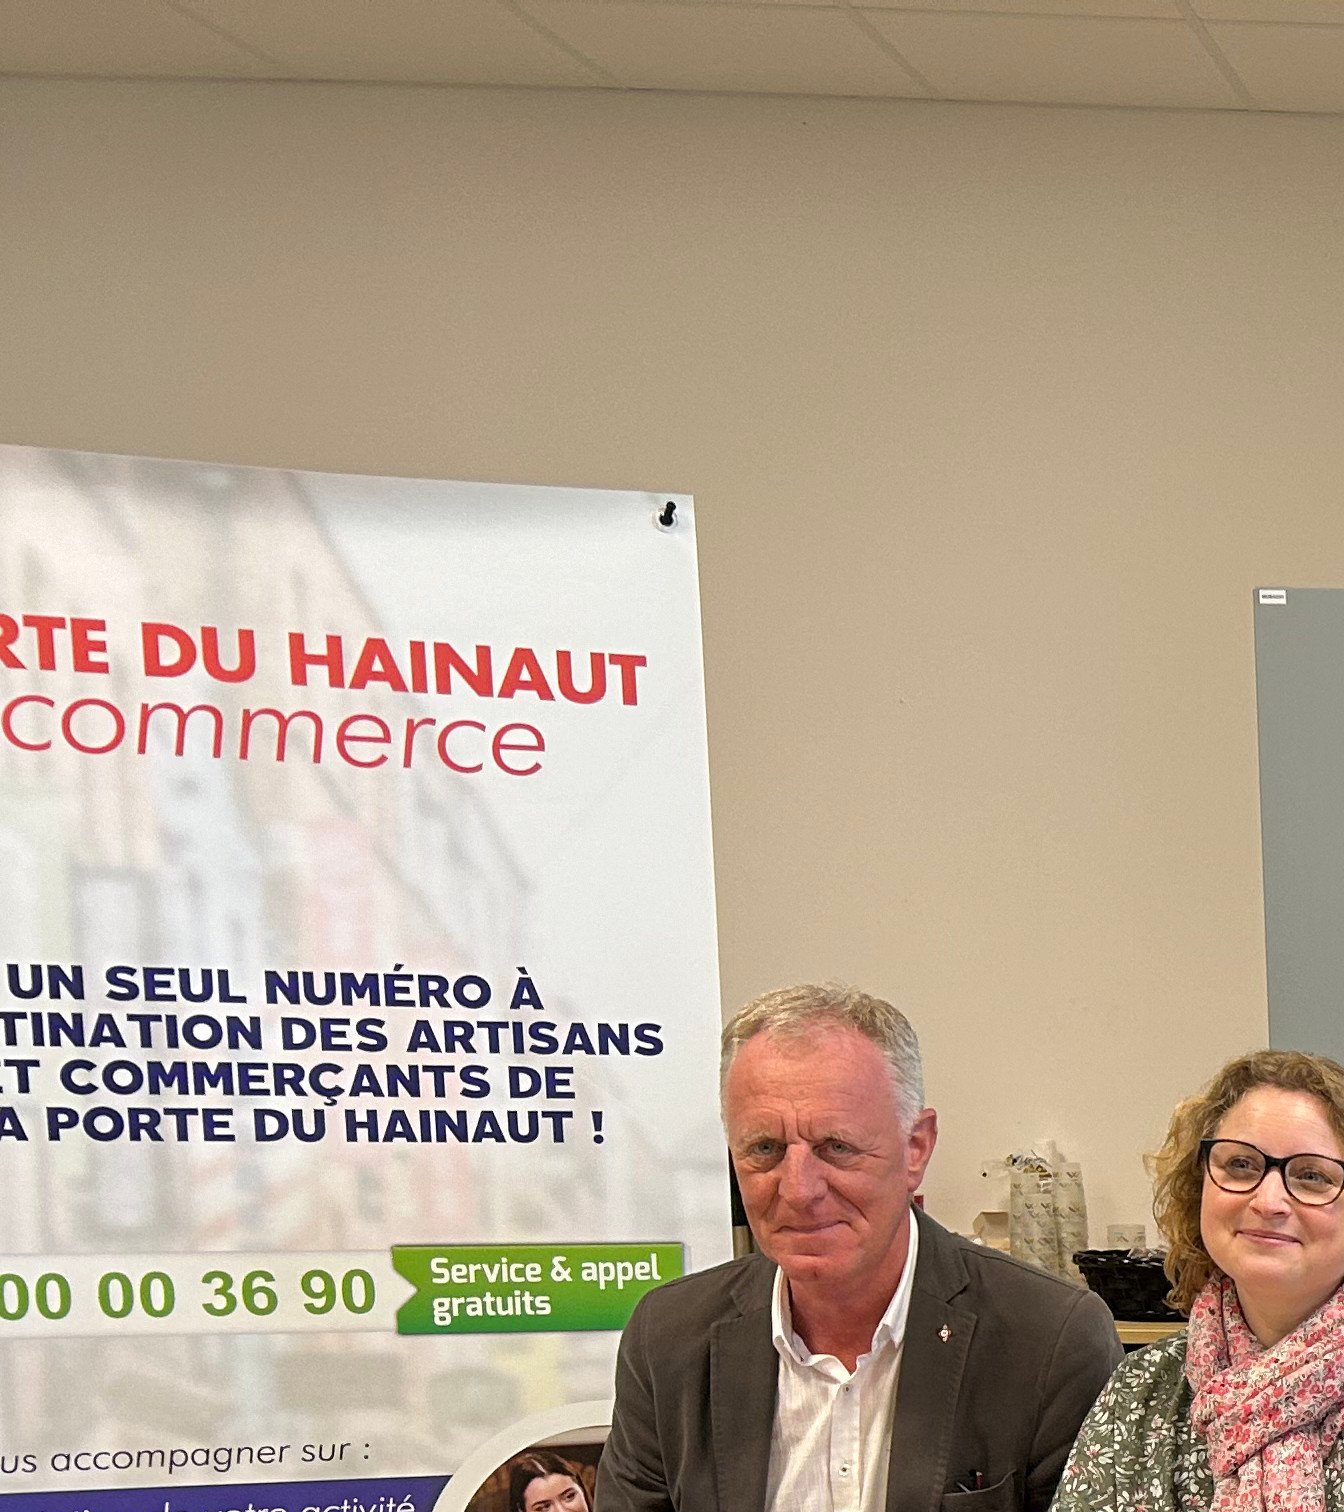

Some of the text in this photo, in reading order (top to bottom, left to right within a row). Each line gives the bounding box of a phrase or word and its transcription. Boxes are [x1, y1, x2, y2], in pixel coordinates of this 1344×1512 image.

[141, 621, 257, 685] DU
[287, 631, 647, 707] HAINAUT
[1, 694, 545, 777] commerce
[6, 962, 545, 1011] UN SEUL NUMÉRO À
[0, 1011, 664, 1057] TINATION DES ARTISANS
[59, 1058, 491, 1107] COMMERÇANTS
[507, 1065, 576, 1100] DE
[45, 1106, 236, 1142] PORTE
[253, 1108, 326, 1143] DU
[344, 1108, 574, 1144] HAINAUT
[0, 1267, 376, 1321] 00 00 36 90
[430, 1252, 662, 1290] Service & appel
[432, 1290, 552, 1326] gratuits
[0, 1454, 37, 1474] us
[50, 1445, 291, 1475] accompagner
[301, 1442, 352, 1463] sur
